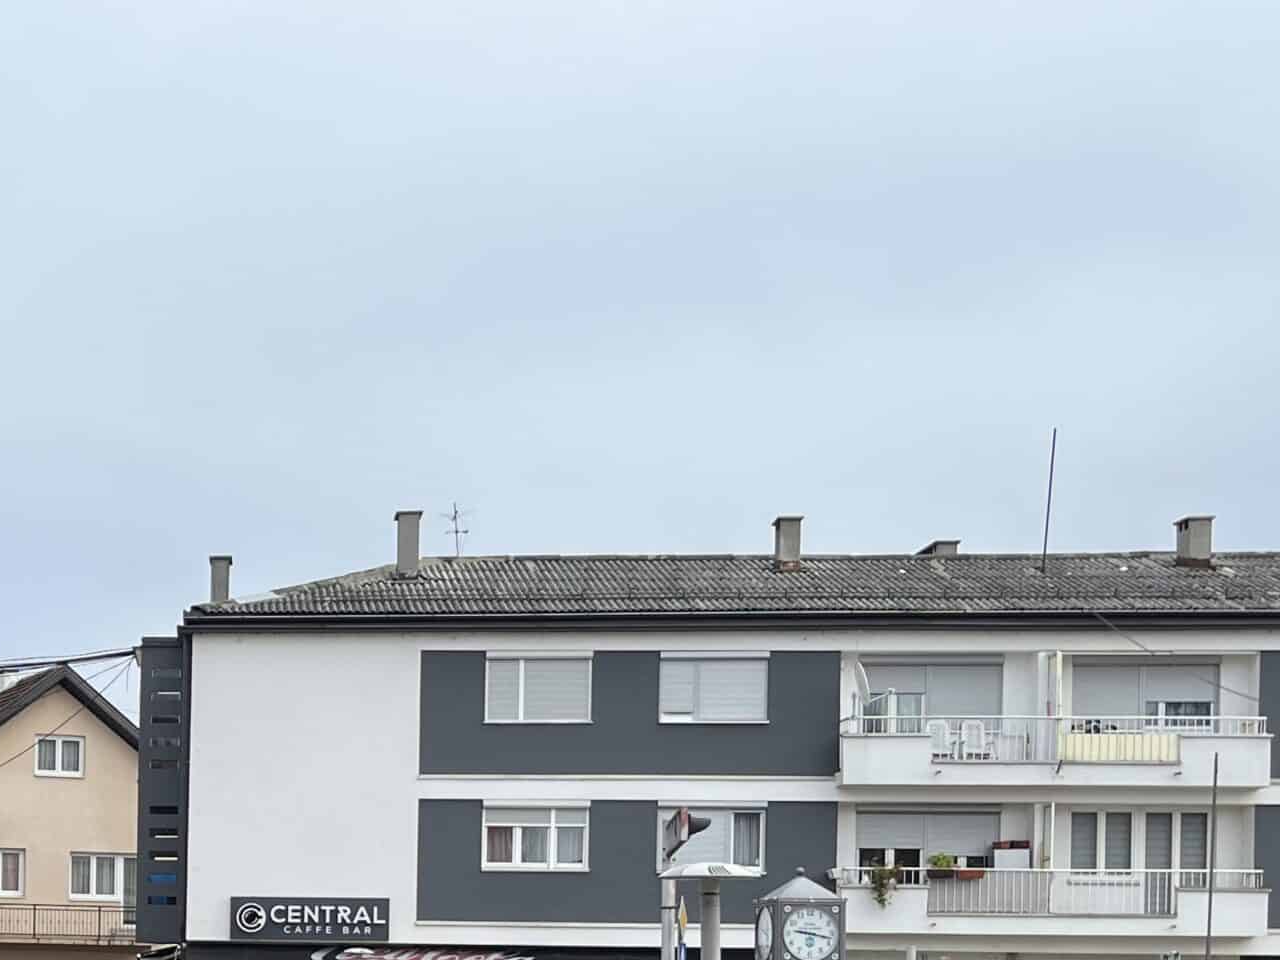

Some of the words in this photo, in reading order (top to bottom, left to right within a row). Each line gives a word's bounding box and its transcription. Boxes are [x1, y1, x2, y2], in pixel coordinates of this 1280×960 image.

[270, 904, 386, 924] CENTRAL
[283, 925, 333, 934] CAFFE
[342, 926, 372, 935] BAR
